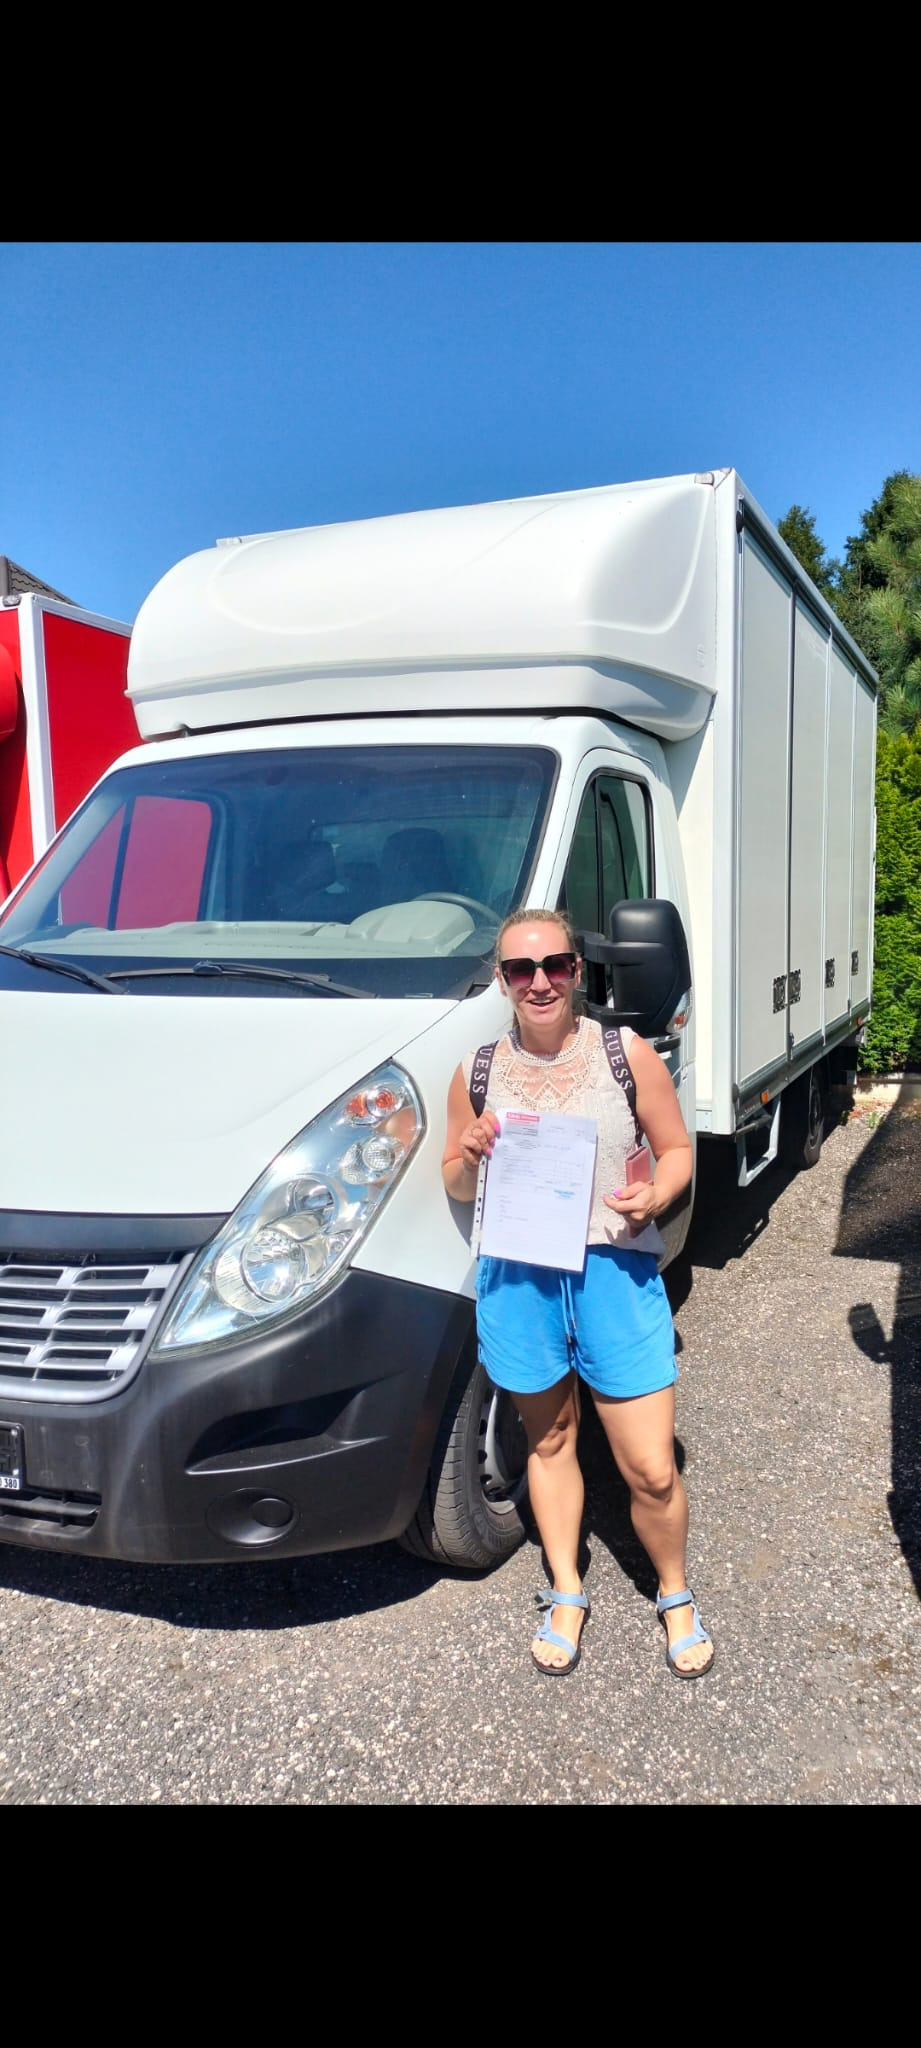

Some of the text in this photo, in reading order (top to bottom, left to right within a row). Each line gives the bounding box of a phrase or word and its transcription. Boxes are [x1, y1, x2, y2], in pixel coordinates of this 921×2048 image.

[472, 1047, 493, 1094] UESS
[604, 1030, 633, 1090] GUESS
[4, 1478, 18, 1489] 380
